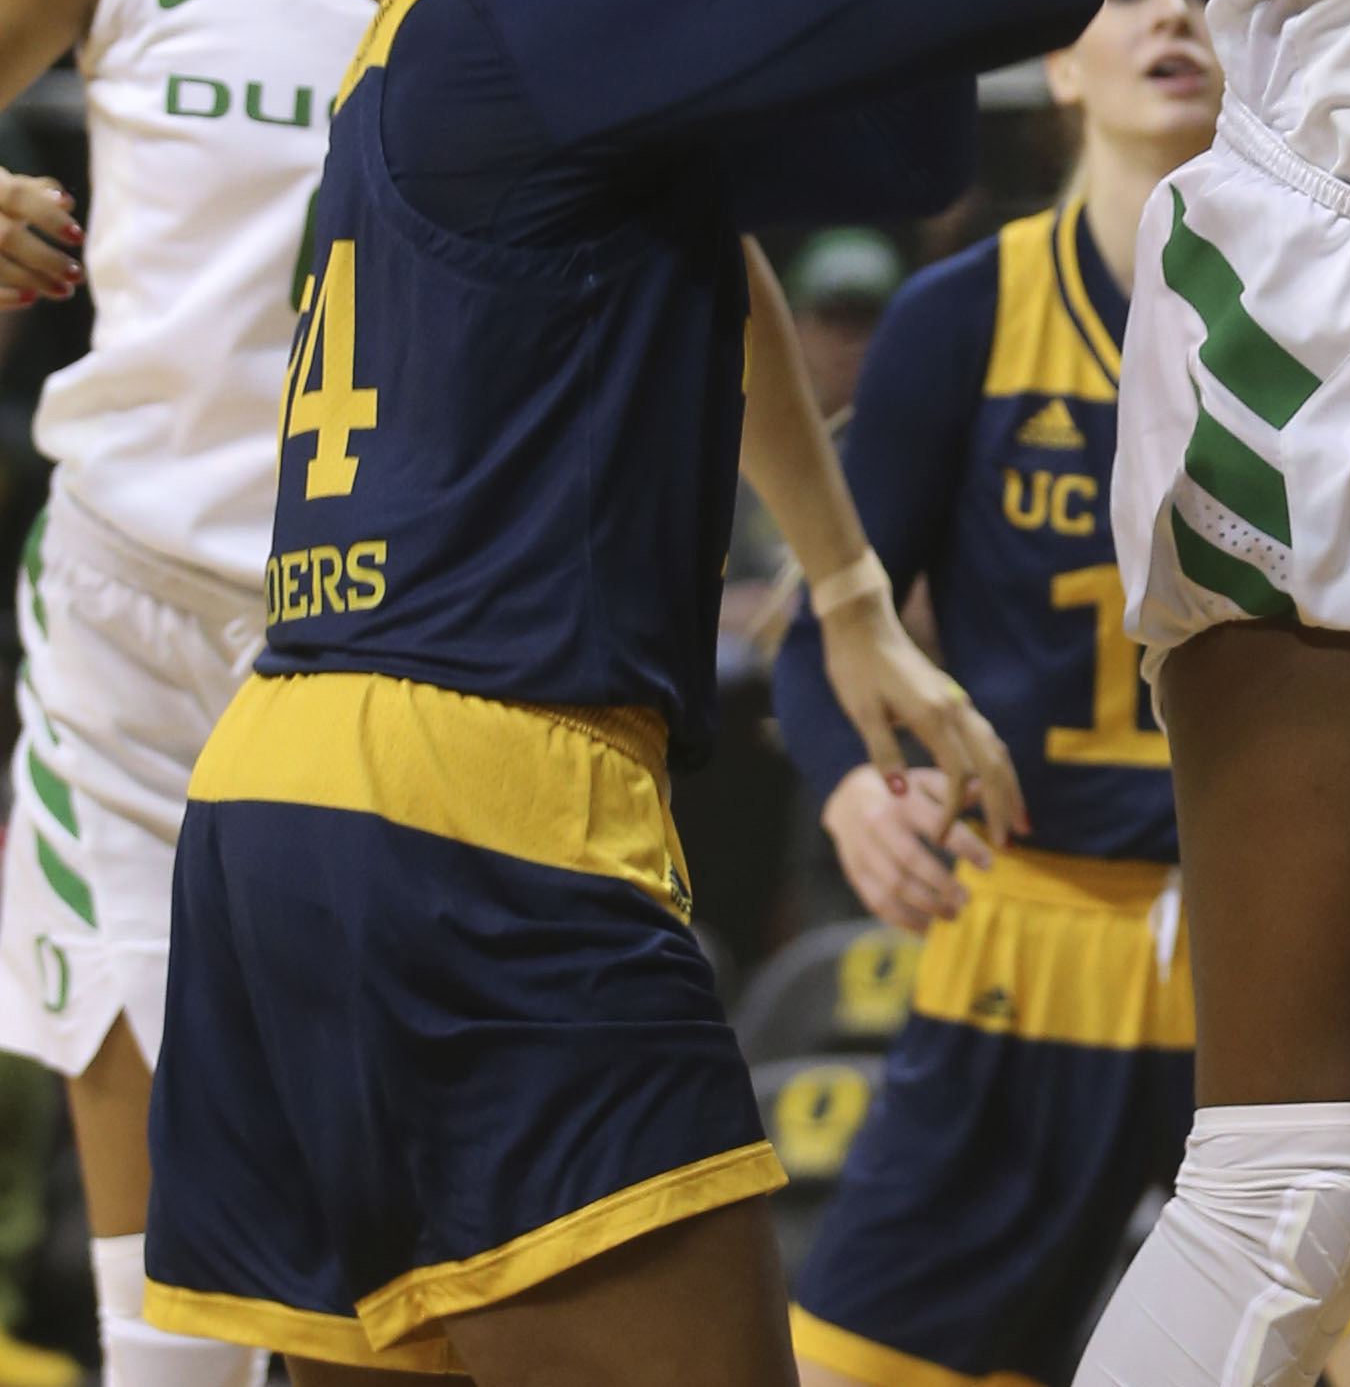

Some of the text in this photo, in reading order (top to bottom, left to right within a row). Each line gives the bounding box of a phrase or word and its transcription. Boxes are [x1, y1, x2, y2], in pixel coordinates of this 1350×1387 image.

[166, 73, 338, 127] DU
[276, 238, 378, 501] 4
[1003, 467, 1098, 537] UC
[1045, 563, 1172, 769] 1
